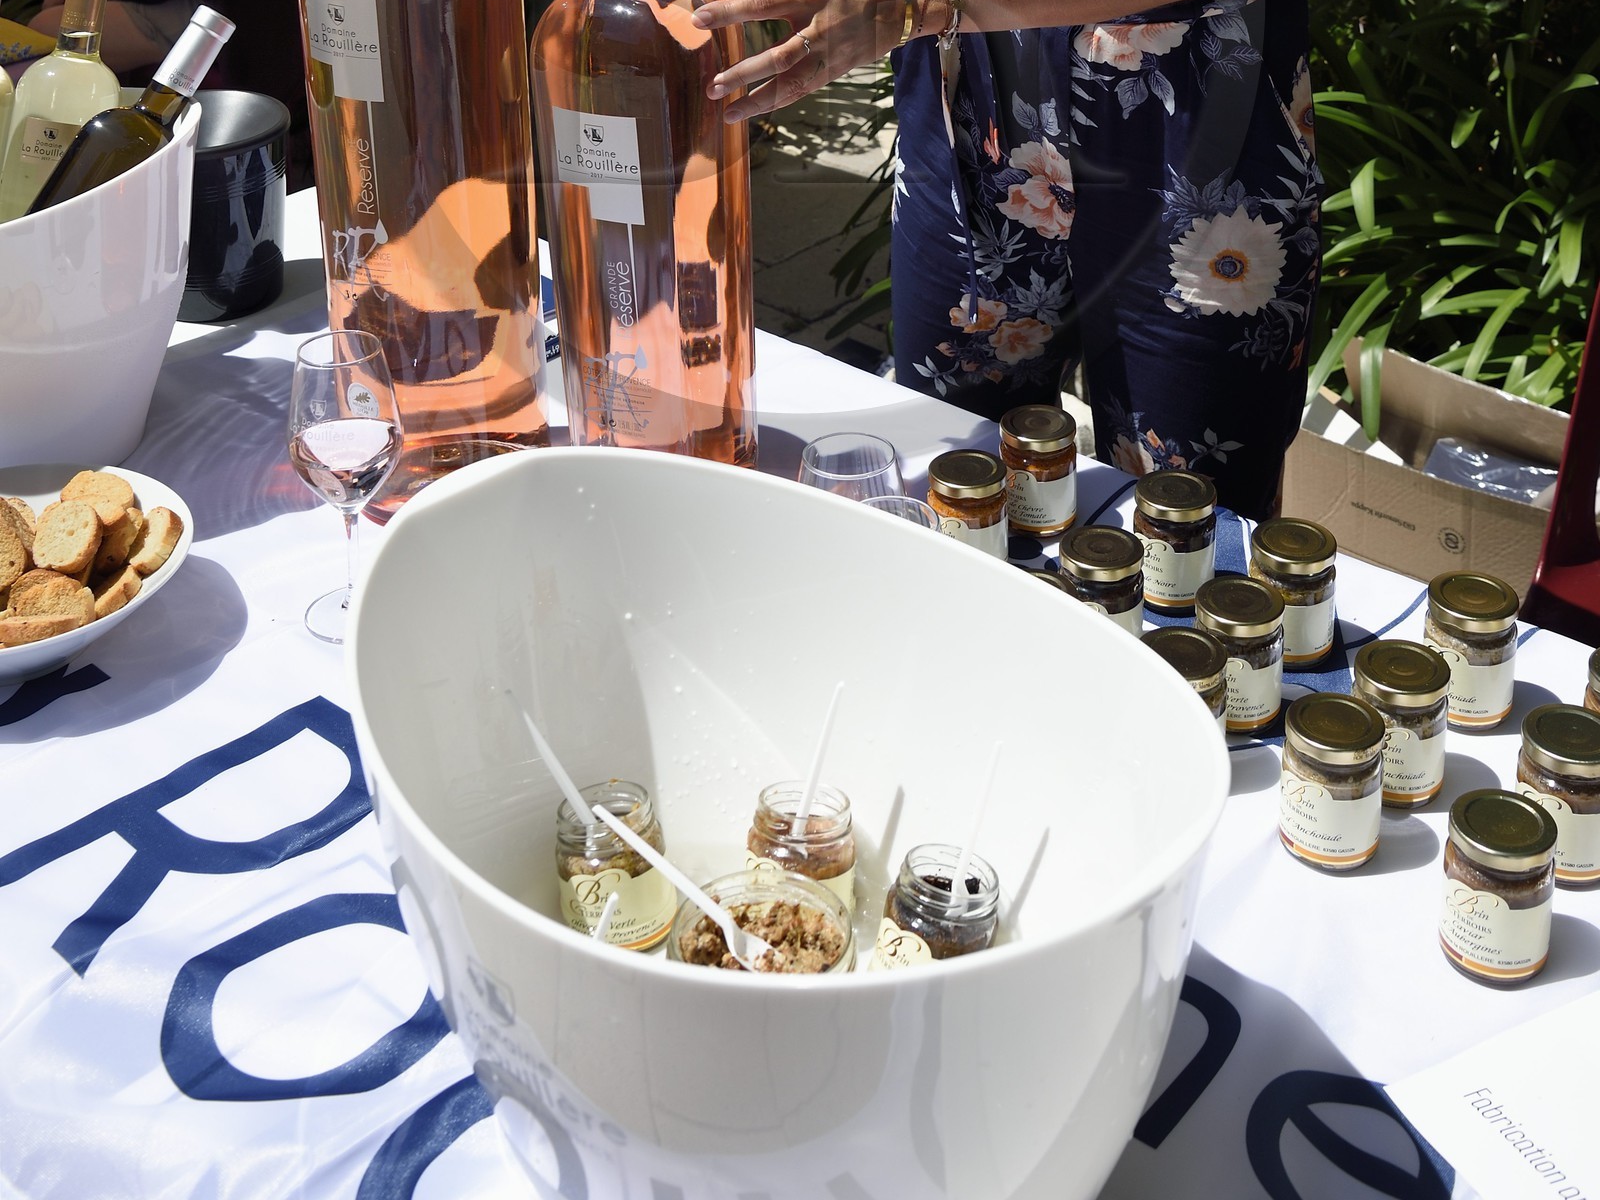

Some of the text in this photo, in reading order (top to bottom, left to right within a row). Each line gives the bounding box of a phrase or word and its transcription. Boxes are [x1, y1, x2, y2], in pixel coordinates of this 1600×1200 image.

[321, 22, 357, 38] Domaine
[322, 34, 378, 53] Rouillère
[21, 144, 31, 152] La
[35, 139, 63, 148] Domaine
[575, 143, 617, 158] Domaine
[557, 149, 639, 174] La Rouillère
[356, 137, 376, 216] Réserve
[606, 260, 618, 310] GRANDE
[1153, 578, 1177, 589] Noire
[1286, 779, 1324, 810] Brin
[575, 872, 621, 906] Bri
[1452, 888, 1499, 921] Brin
[609, 916, 637, 931] Verte
[1452, 919, 1486, 940] Caviar
[1513, 958, 1532, 966] GASSIN
[1463, 1087, 1567, 1185] Fabrication
